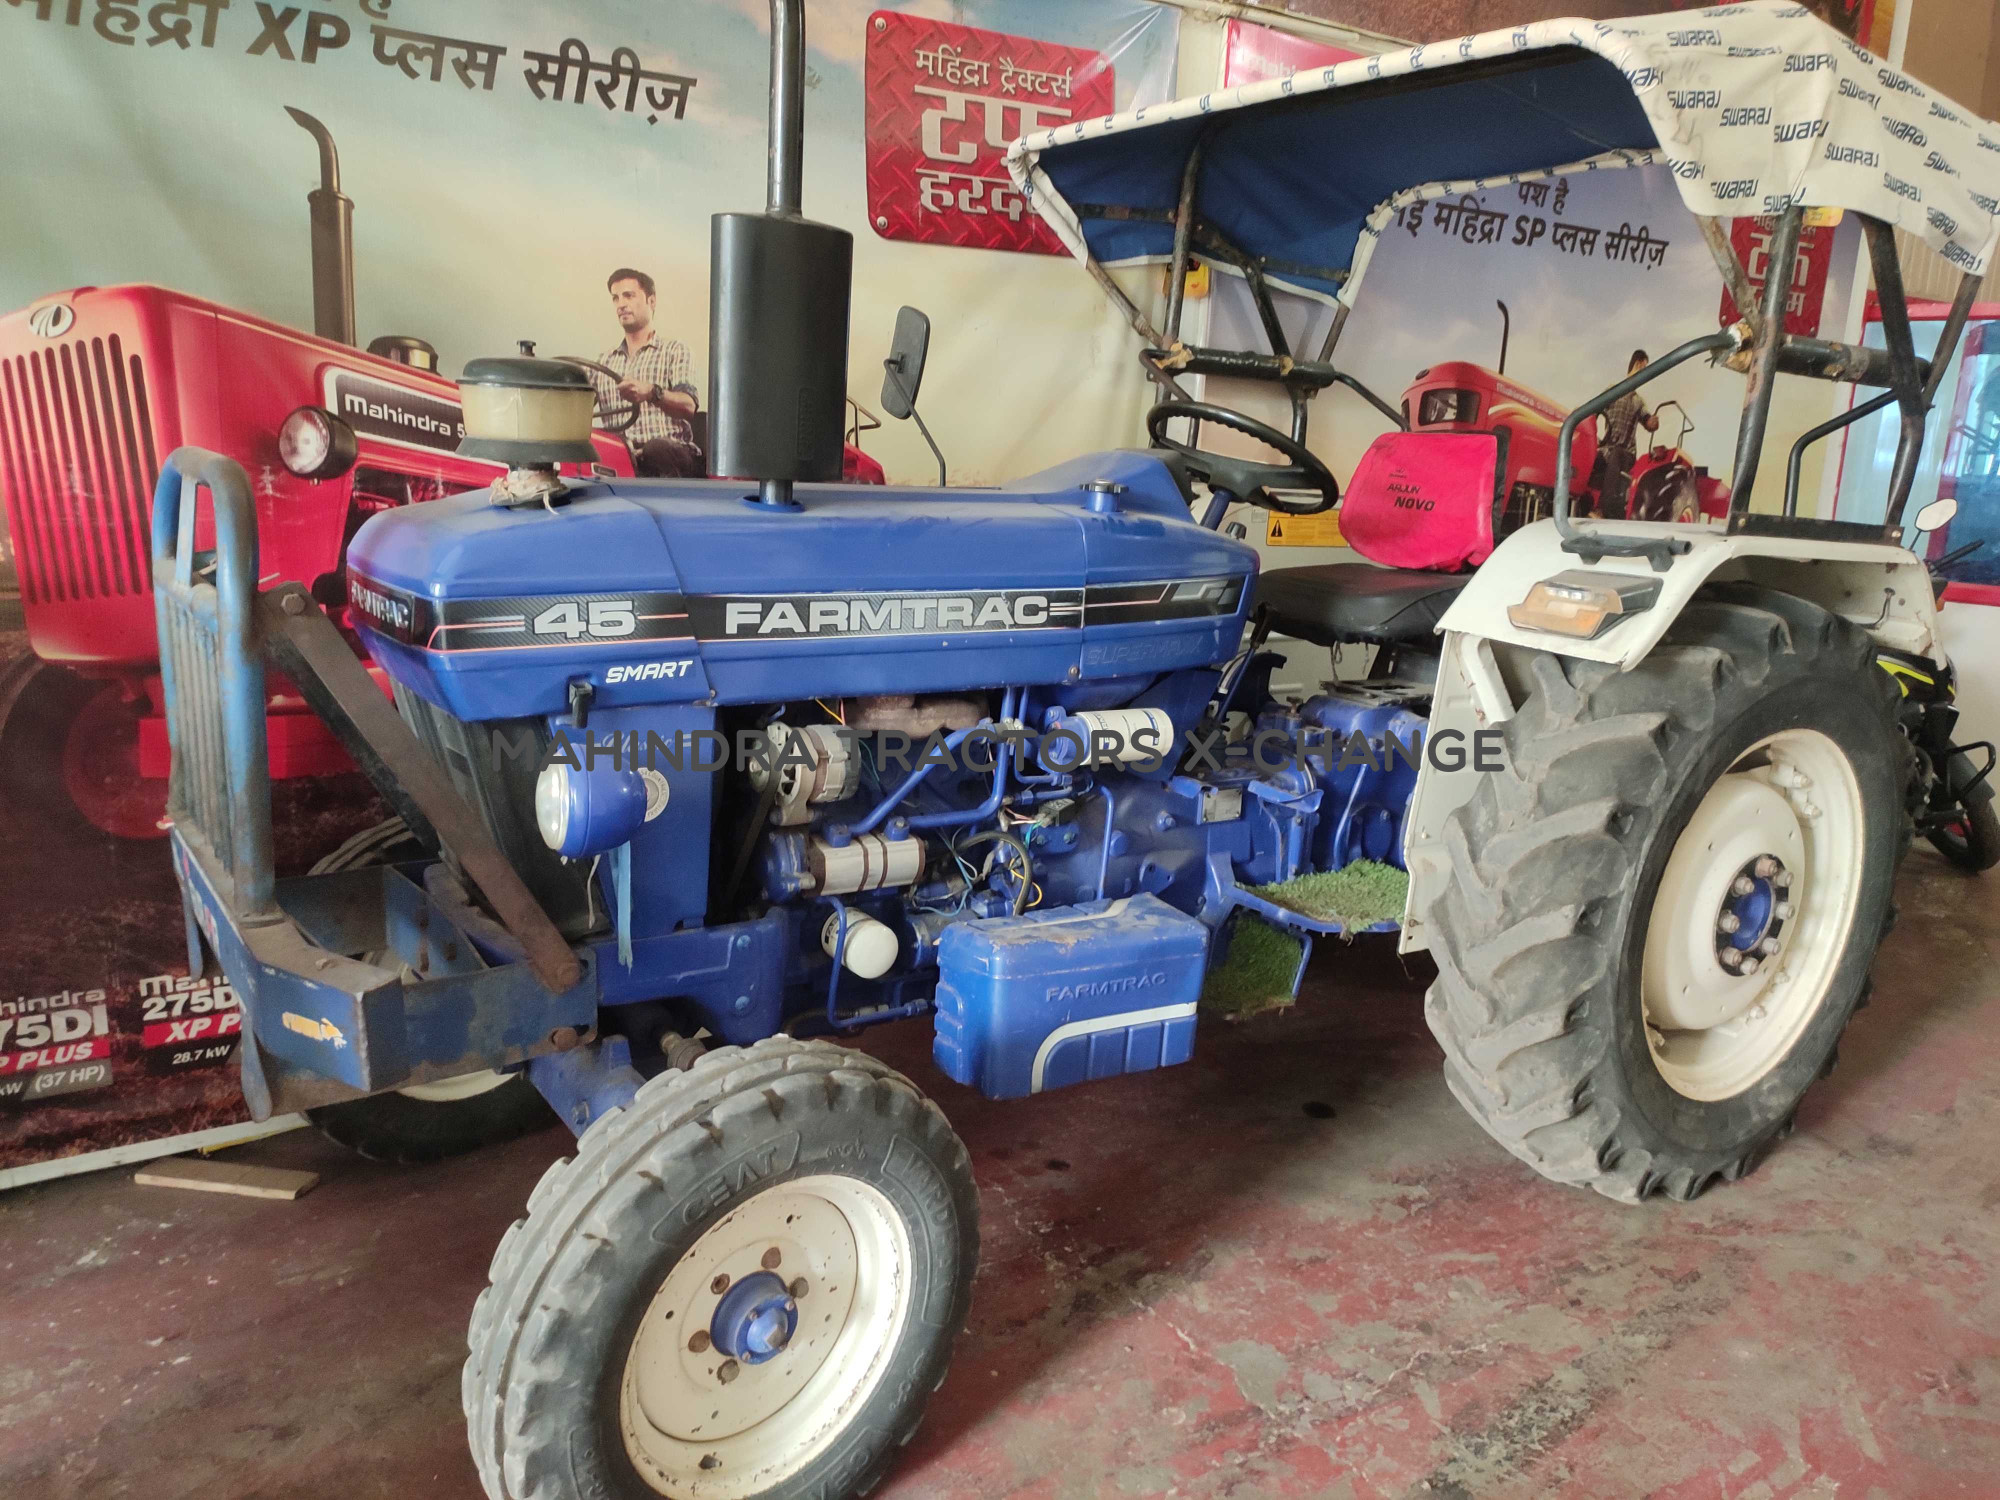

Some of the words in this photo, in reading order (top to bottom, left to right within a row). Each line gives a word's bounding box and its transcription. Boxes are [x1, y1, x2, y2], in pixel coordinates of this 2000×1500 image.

[245, 1, 351, 65] XP
[369, 24, 507, 91] प्लस
[915, 44, 990, 86] महिंद्रा
[1511, 215, 1547, 246] SP
[1552, 222, 1601, 256] प्लस
[1394, 496, 1436, 511] NOVO
[533, 600, 636, 639] 45
[725, 595, 1049, 635] FARMTRAC
[605, 660, 694, 684] SMART
[1046, 972, 1165, 1002] FARMTRAC
[142, 986, 241, 1021] 275D
[164, 1017, 212, 1043] XP
[16, 1042, 94, 1070] PLUS
[172, 1049, 204, 1065] 28.7
[206, 1044, 230, 1059] kW
[35, 1071, 66, 1092] (37
[69, 1064, 106, 1083] HP)
[683, 1146, 778, 1225] CEAT
